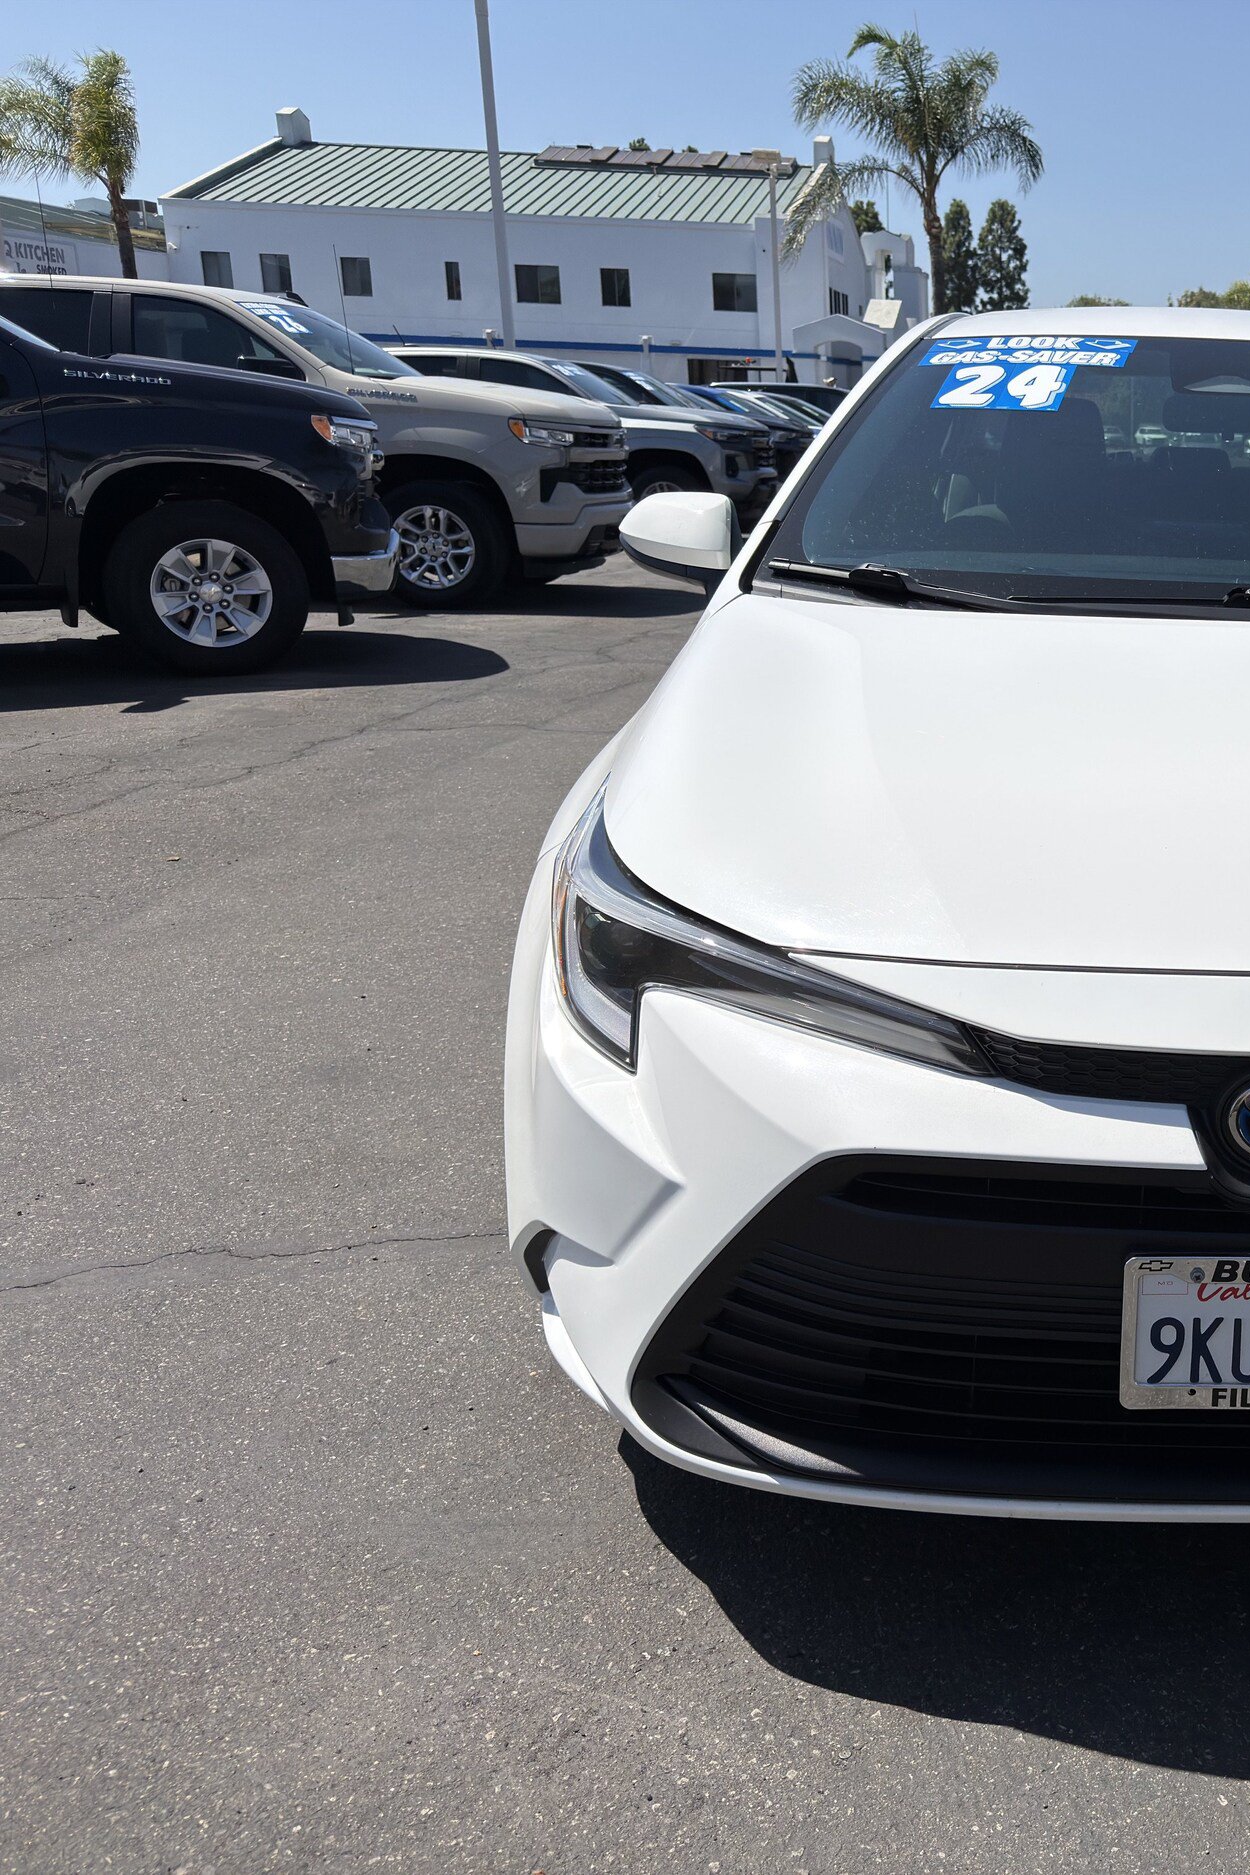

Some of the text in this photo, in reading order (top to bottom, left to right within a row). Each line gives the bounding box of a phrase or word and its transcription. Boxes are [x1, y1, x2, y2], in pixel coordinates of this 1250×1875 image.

[14, 241, 66, 264] KITCHEN
[36, 264, 68, 276] SMOKED
[987, 336, 1085, 350] LOOK
[928, 350, 1122, 367] GAS-SAVER
[63, 369, 172, 386] SILVERADO
[938, 364, 1067, 409] 24
